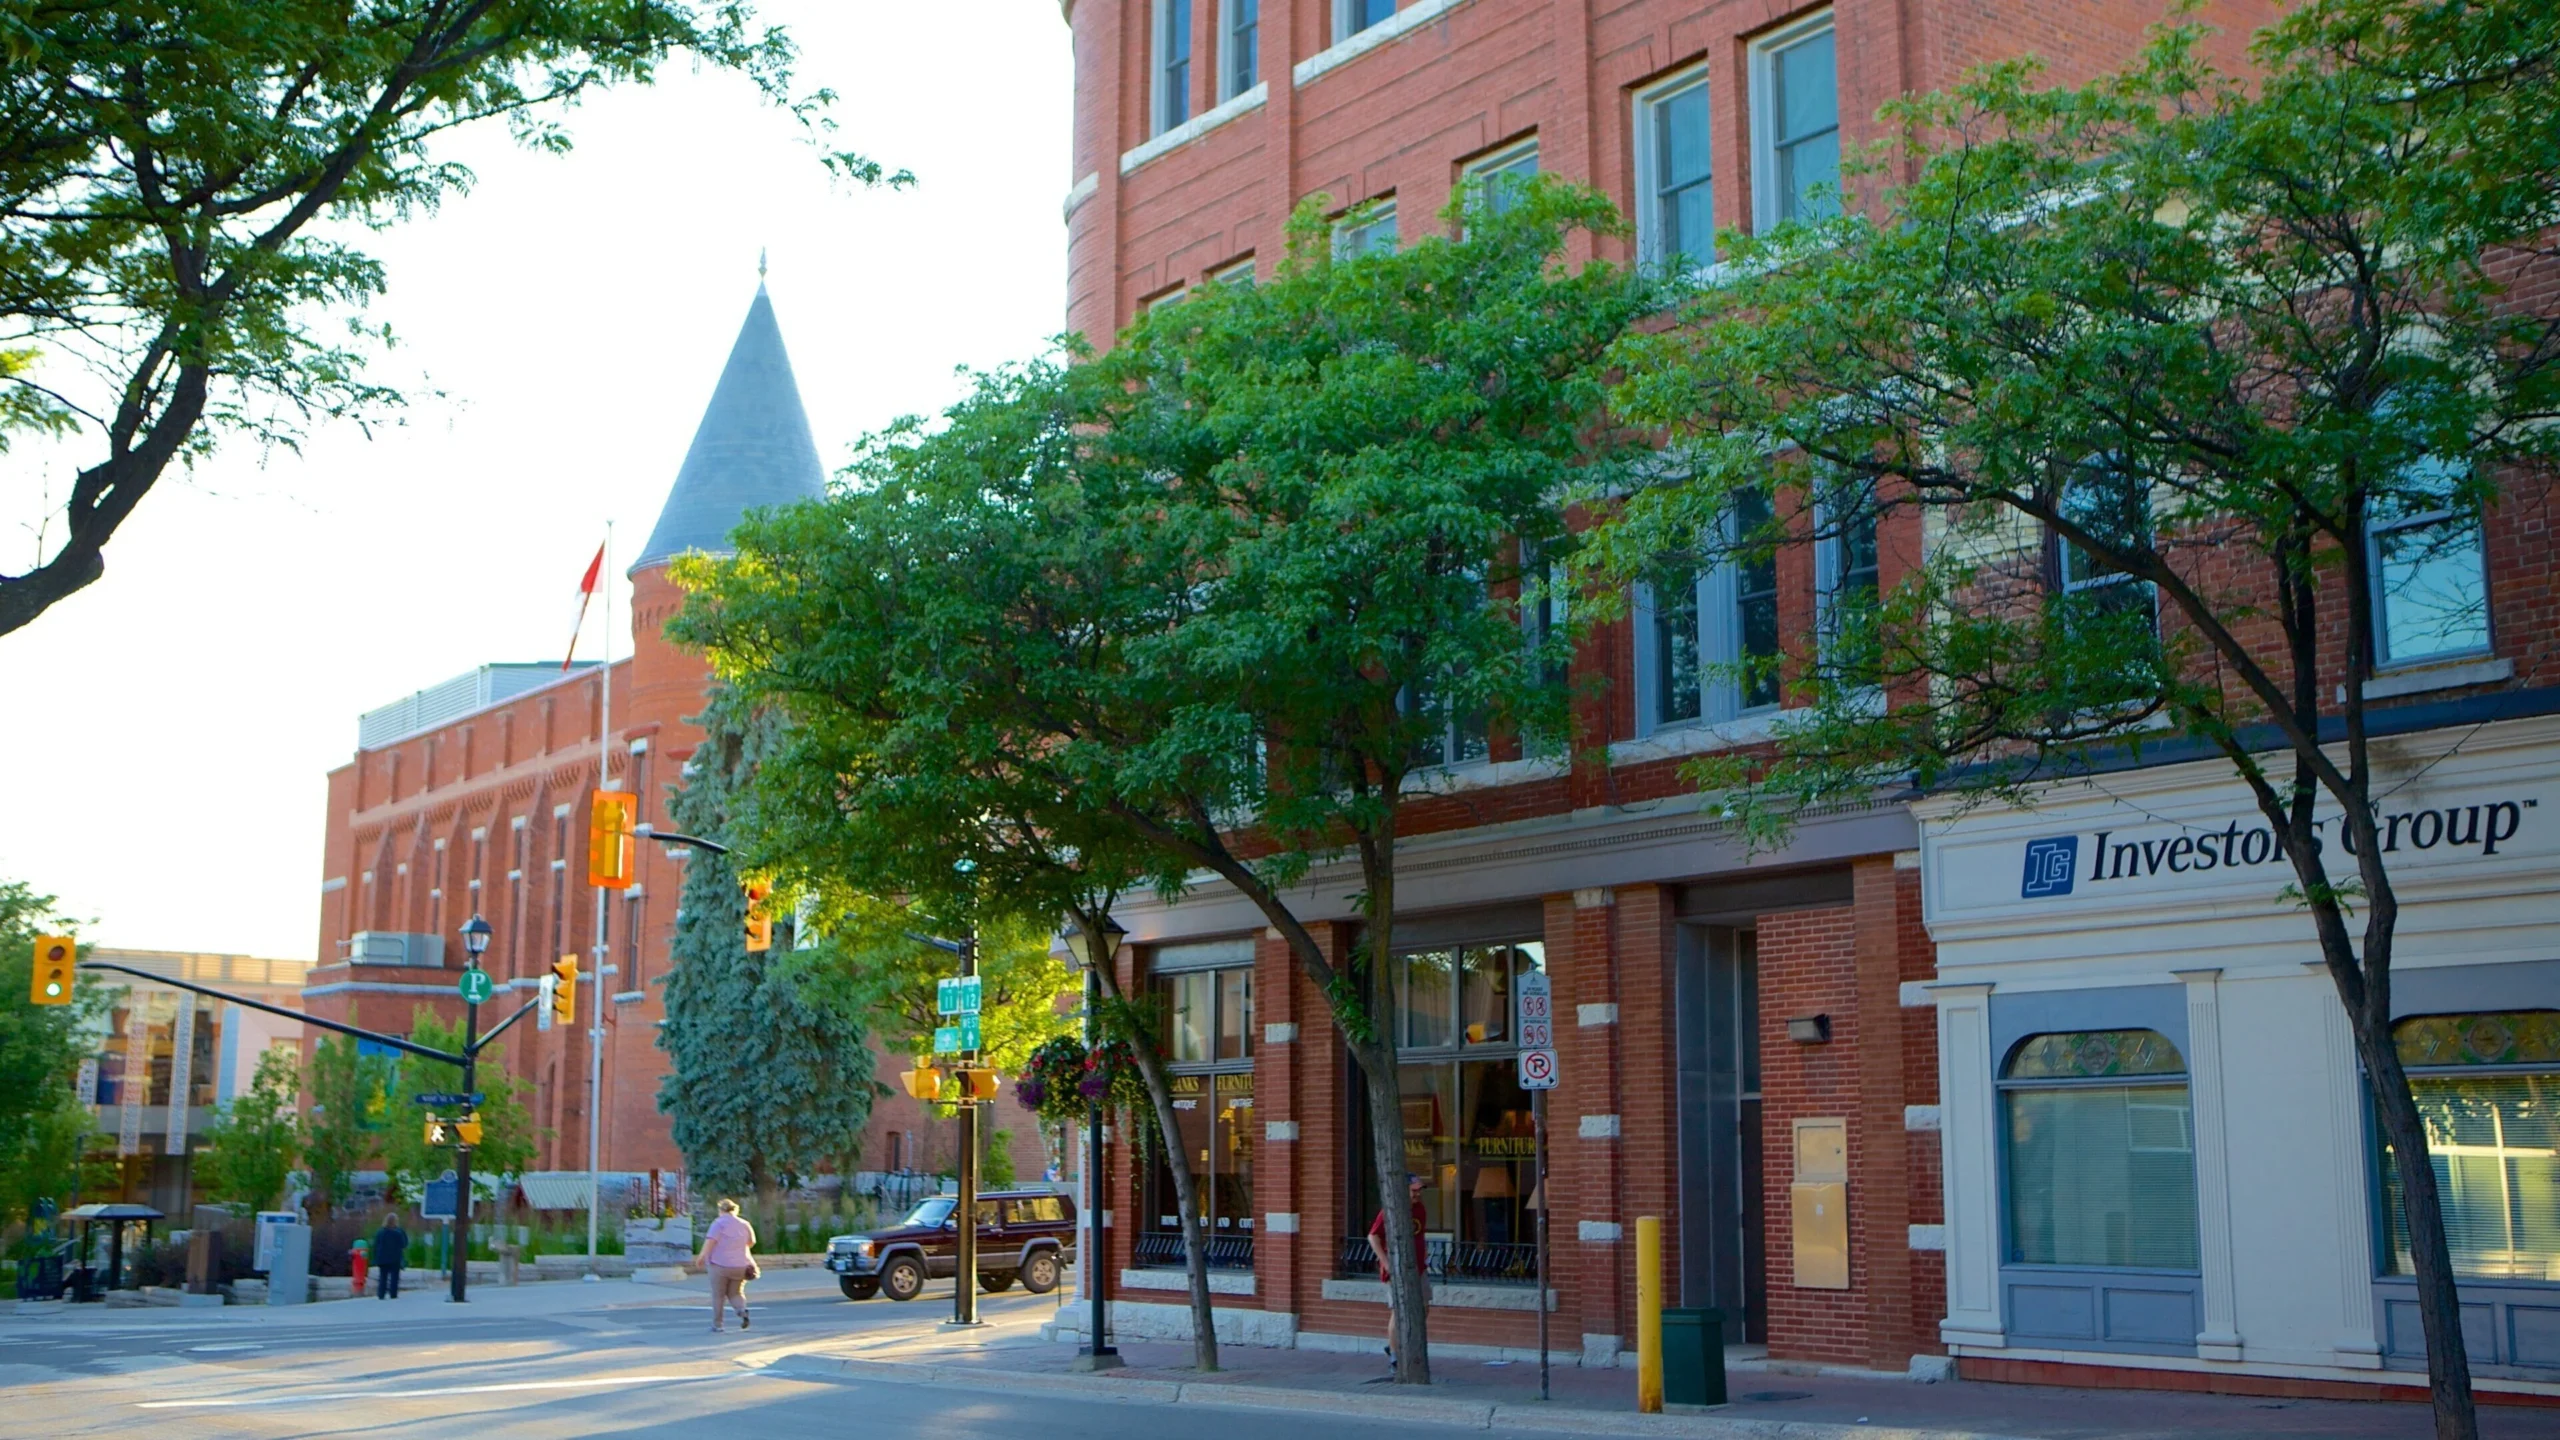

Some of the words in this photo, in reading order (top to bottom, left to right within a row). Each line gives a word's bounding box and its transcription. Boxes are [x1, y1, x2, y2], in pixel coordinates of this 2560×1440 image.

[966, 993, 977, 1008] 12
[1169, 1076, 1200, 1092] ANKS
[1479, 1137, 1537, 1154] FURNITUR
